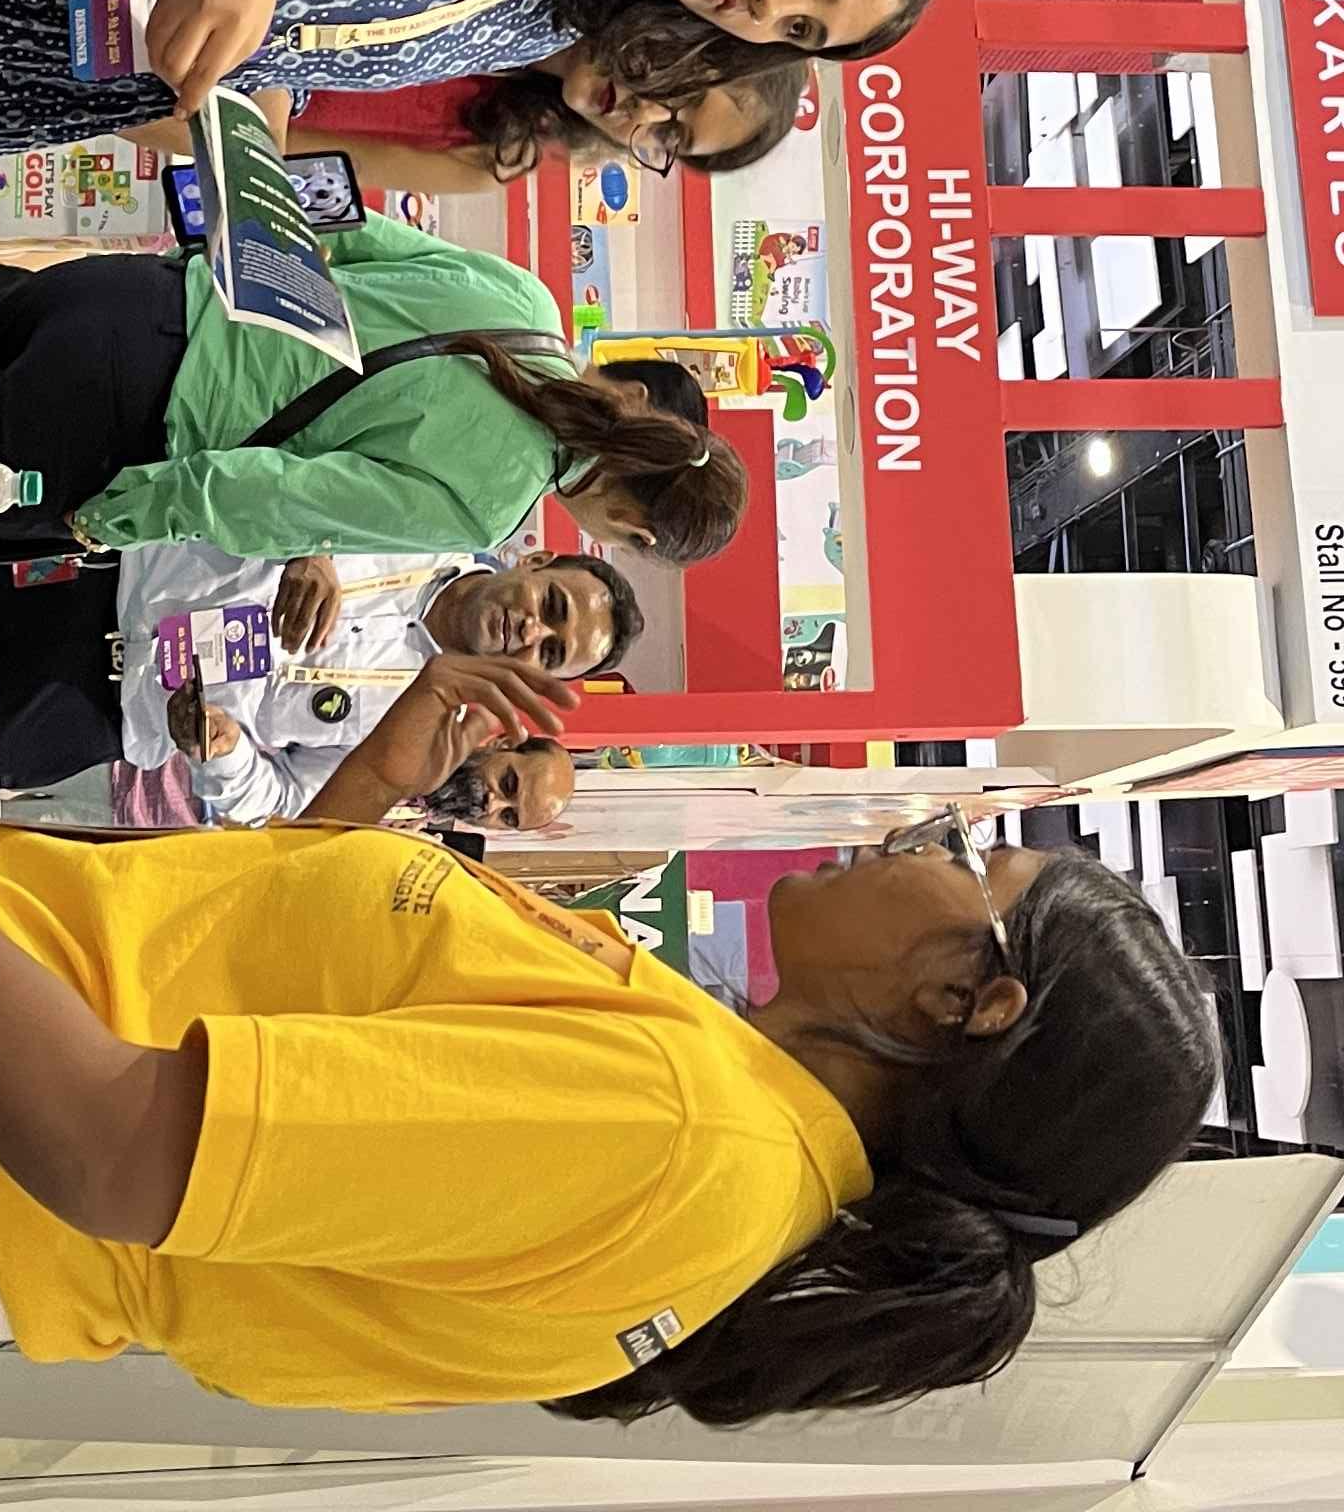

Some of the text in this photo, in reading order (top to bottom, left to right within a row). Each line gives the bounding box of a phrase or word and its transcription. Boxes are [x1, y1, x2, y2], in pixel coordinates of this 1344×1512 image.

[75, 8, 87, 66] DESIGNER
[25, 153, 44, 218] GOLF
[45, 153, 55, 218] LET'S PLAY
[778, 276, 792, 315] Swing
[791, 276, 802, 304] Baby
[856, 64, 922, 473] CORPORATION
[926, 168, 981, 361] HI-WAY
